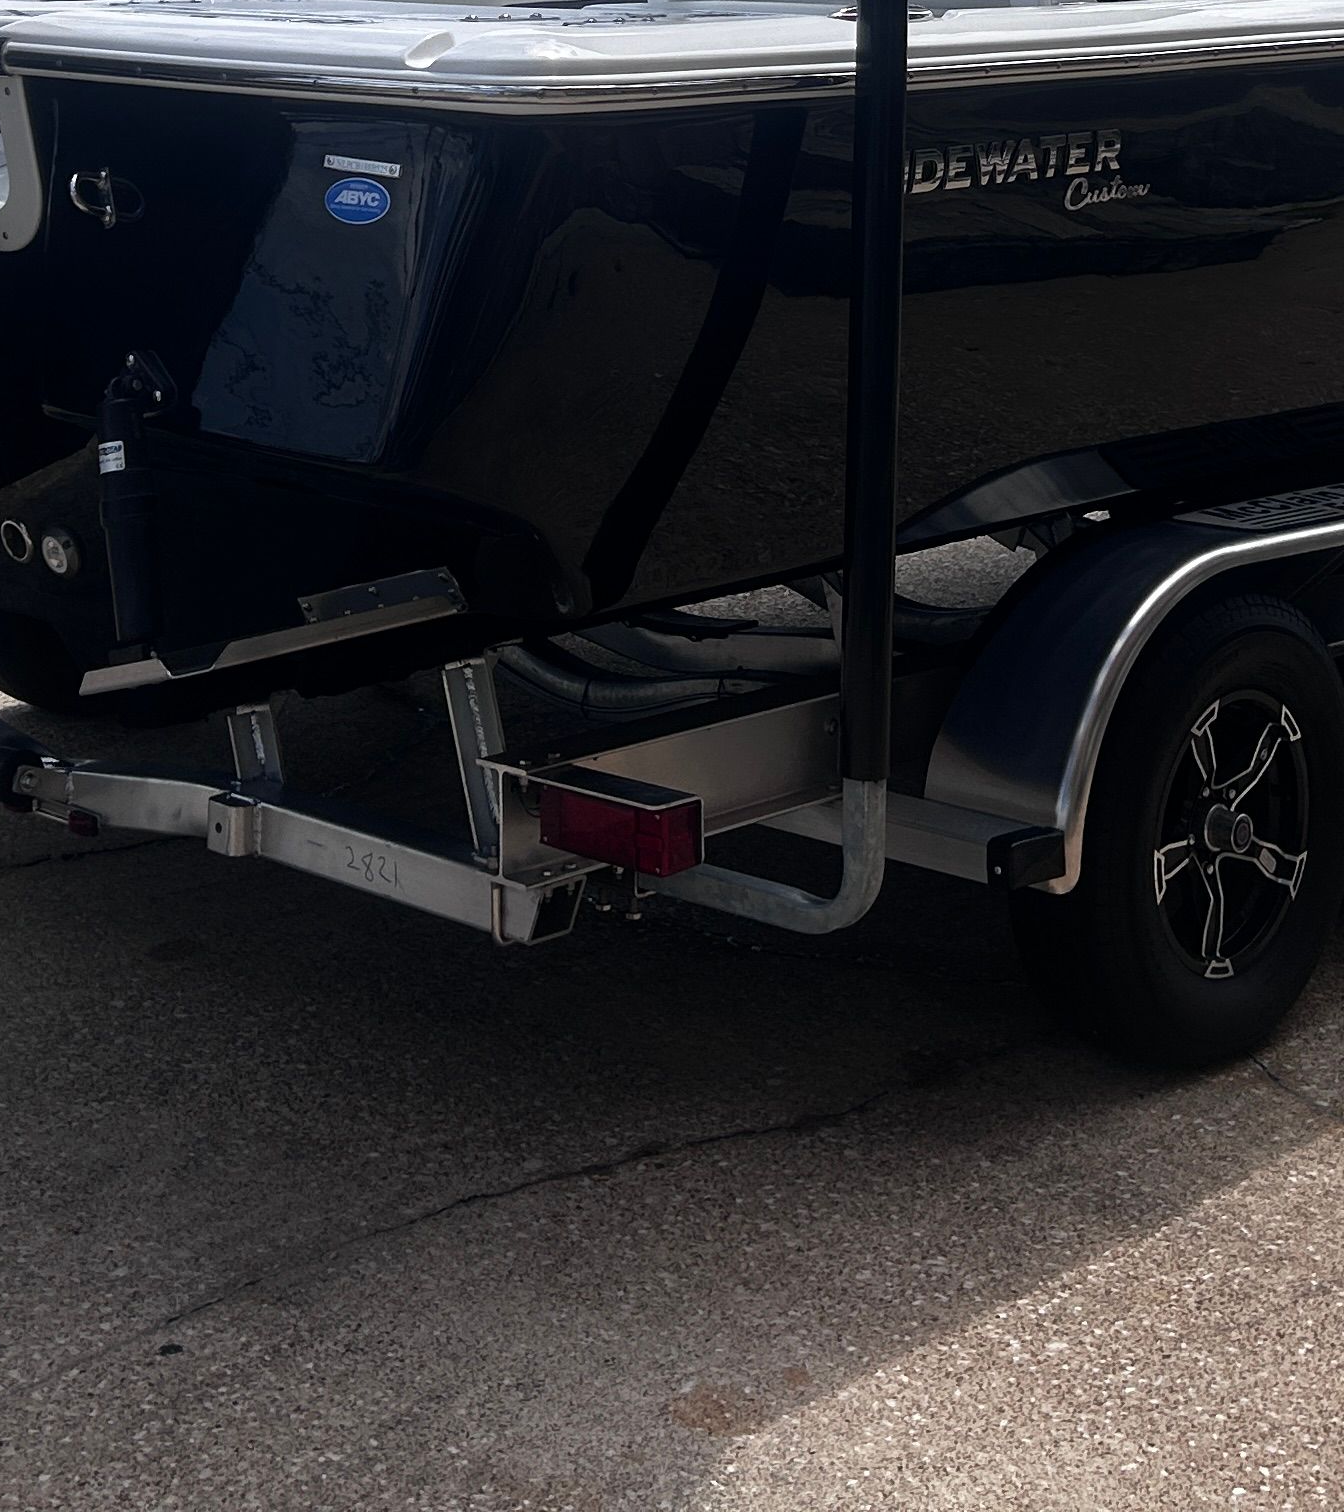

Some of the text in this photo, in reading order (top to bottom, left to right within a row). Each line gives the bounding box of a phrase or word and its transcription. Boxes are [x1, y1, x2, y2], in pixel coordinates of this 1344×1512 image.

[334, 189, 381, 207] ABYC
[1064, 175, 1151, 211] Custom
[345, 845, 398, 888] 2821
